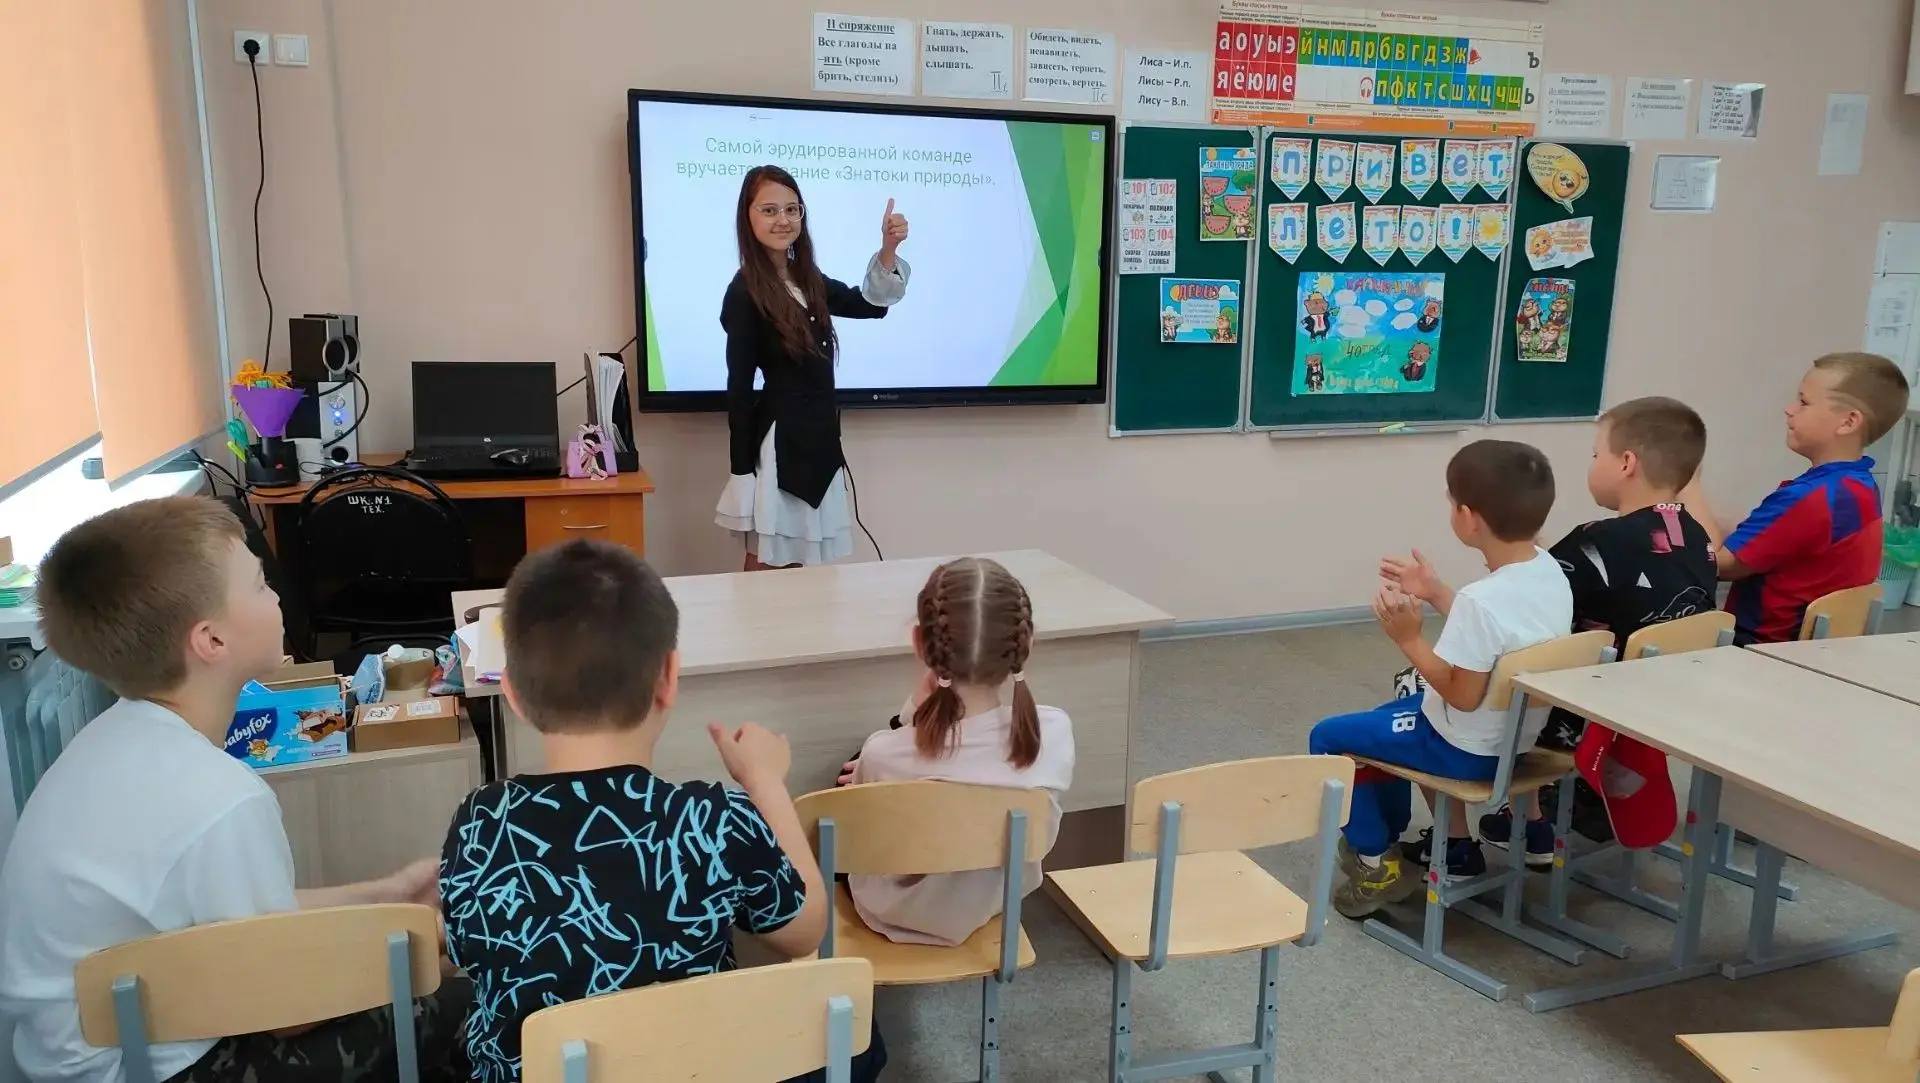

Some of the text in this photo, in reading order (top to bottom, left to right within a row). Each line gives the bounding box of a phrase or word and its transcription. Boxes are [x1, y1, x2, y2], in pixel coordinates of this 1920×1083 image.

[839, 21, 896, 33] спряжение
[925, 25, 1005, 40] Гнать, держать,
[818, 36, 897, 51] Все глаголы на
[1030, 32, 1103, 46] Обидеть, видеть,
[925, 44, 969, 54] дышать,
[1030, 48, 1081, 59] ненавидеть,
[845, 56, 881, 67] (кроме
[925, 60, 975, 70] слышать.
[1030, 62, 1069, 73] зависеть,
[1139, 55, 1163, 67] Лиса
[1173, 58, 1192, 69] И.п.
[818, 70, 899, 86] брить, стелить)
[1029, 76, 1070, 87] смотреть,
[1137, 75, 1164, 87] Лисы
[1174, 78, 1191, 88] Р.п.
[1137, 94, 1162, 107] Лису
[1171, 96, 1189, 107] В.п.
[706, 137, 973, 166] Самой эрудированной команде
[835, 165, 910, 183] «Знатоки
[914, 171, 996, 188] природы».
[1132, 182, 1175, 195] 101 102
[1131, 228, 1146, 240] 103
